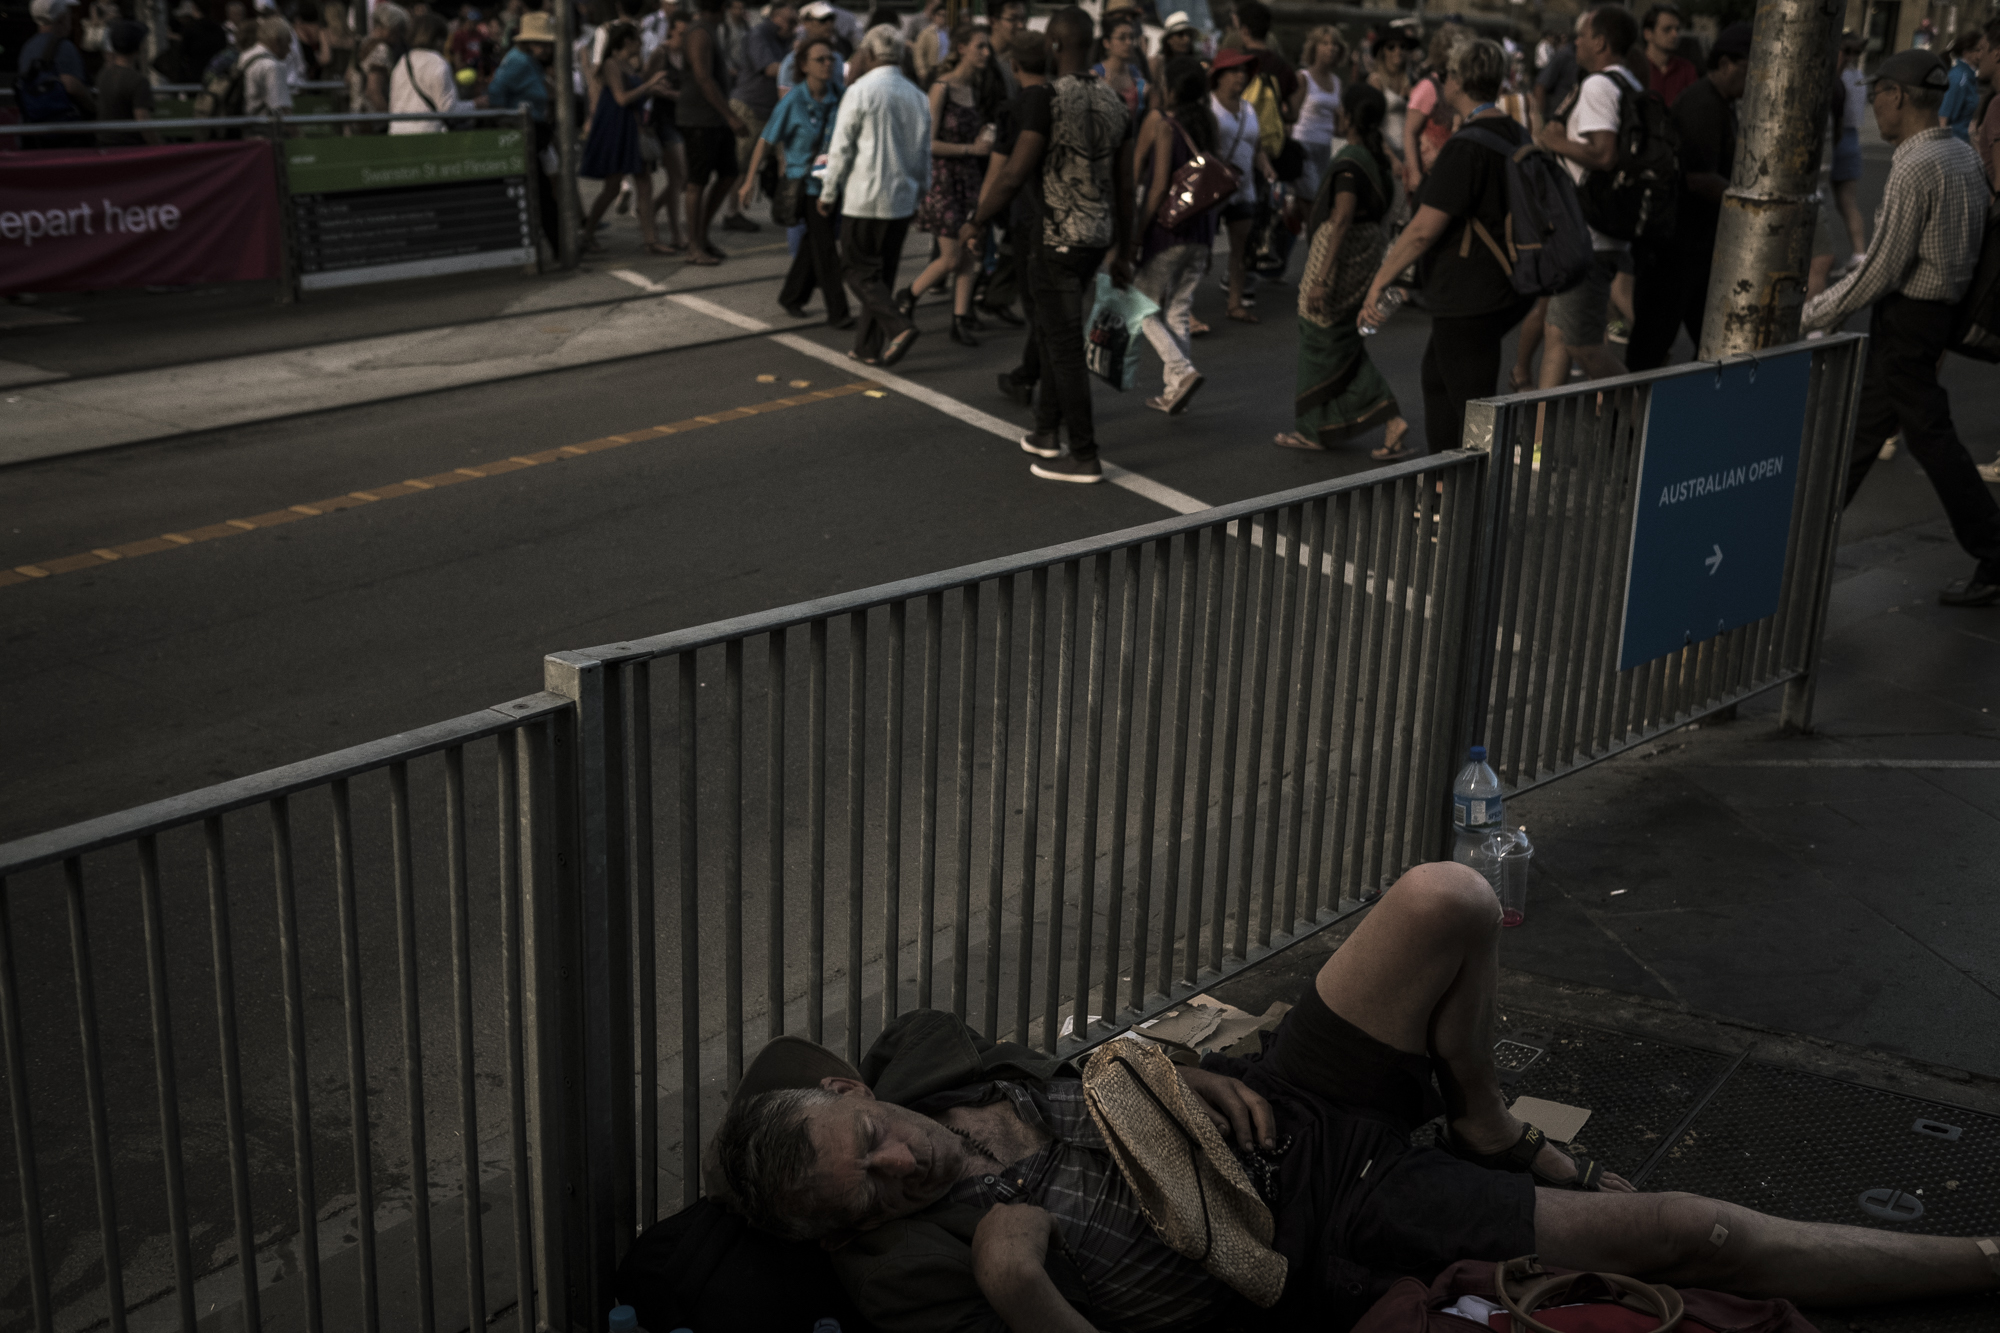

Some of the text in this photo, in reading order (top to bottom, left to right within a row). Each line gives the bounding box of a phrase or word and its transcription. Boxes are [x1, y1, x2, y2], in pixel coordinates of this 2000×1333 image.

[102, 198, 181, 233] here
[1658, 455, 1783, 507] AUSTRALIAN OPEN
